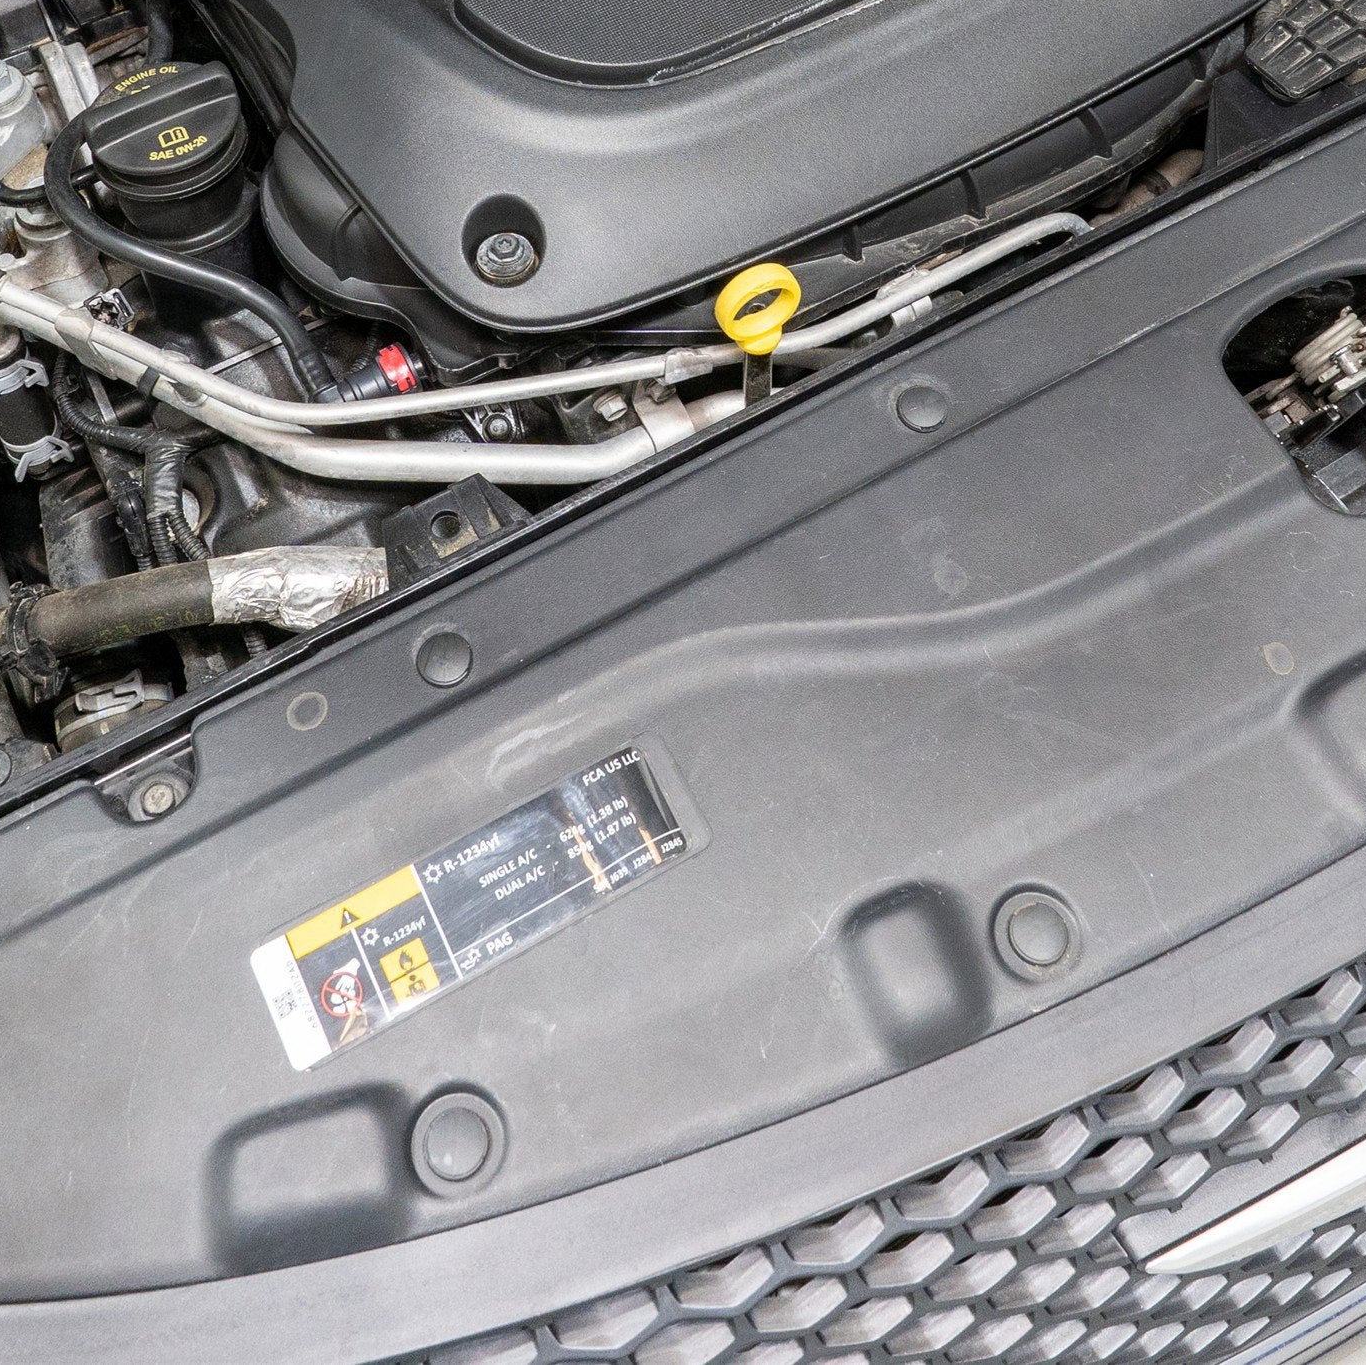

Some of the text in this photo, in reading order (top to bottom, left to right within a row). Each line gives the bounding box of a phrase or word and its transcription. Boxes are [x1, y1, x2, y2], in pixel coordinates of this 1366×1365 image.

[115, 66, 179, 92] ENGINE OIL
[149, 135, 208, 161] SAE 0W-20
[582, 750, 641, 787] FCA US LLC
[443, 832, 501, 874] R-1234yf
[478, 860, 517, 888] SINGLE
[517, 847, 538, 867] A/C
[586, 805, 613, 829] (1.38
[612, 795, 629, 813] lb)
[494, 878, 526, 901] DUAL
[525, 864, 546, 884] A/C
[594, 820, 621, 845] (1.87
[620, 811, 637, 828] lb)
[610, 866, 629, 885] J639
[661, 837, 683, 854] J2845
[382, 915, 427, 947] R-1234yf
[485, 931, 513, 955] PAG
